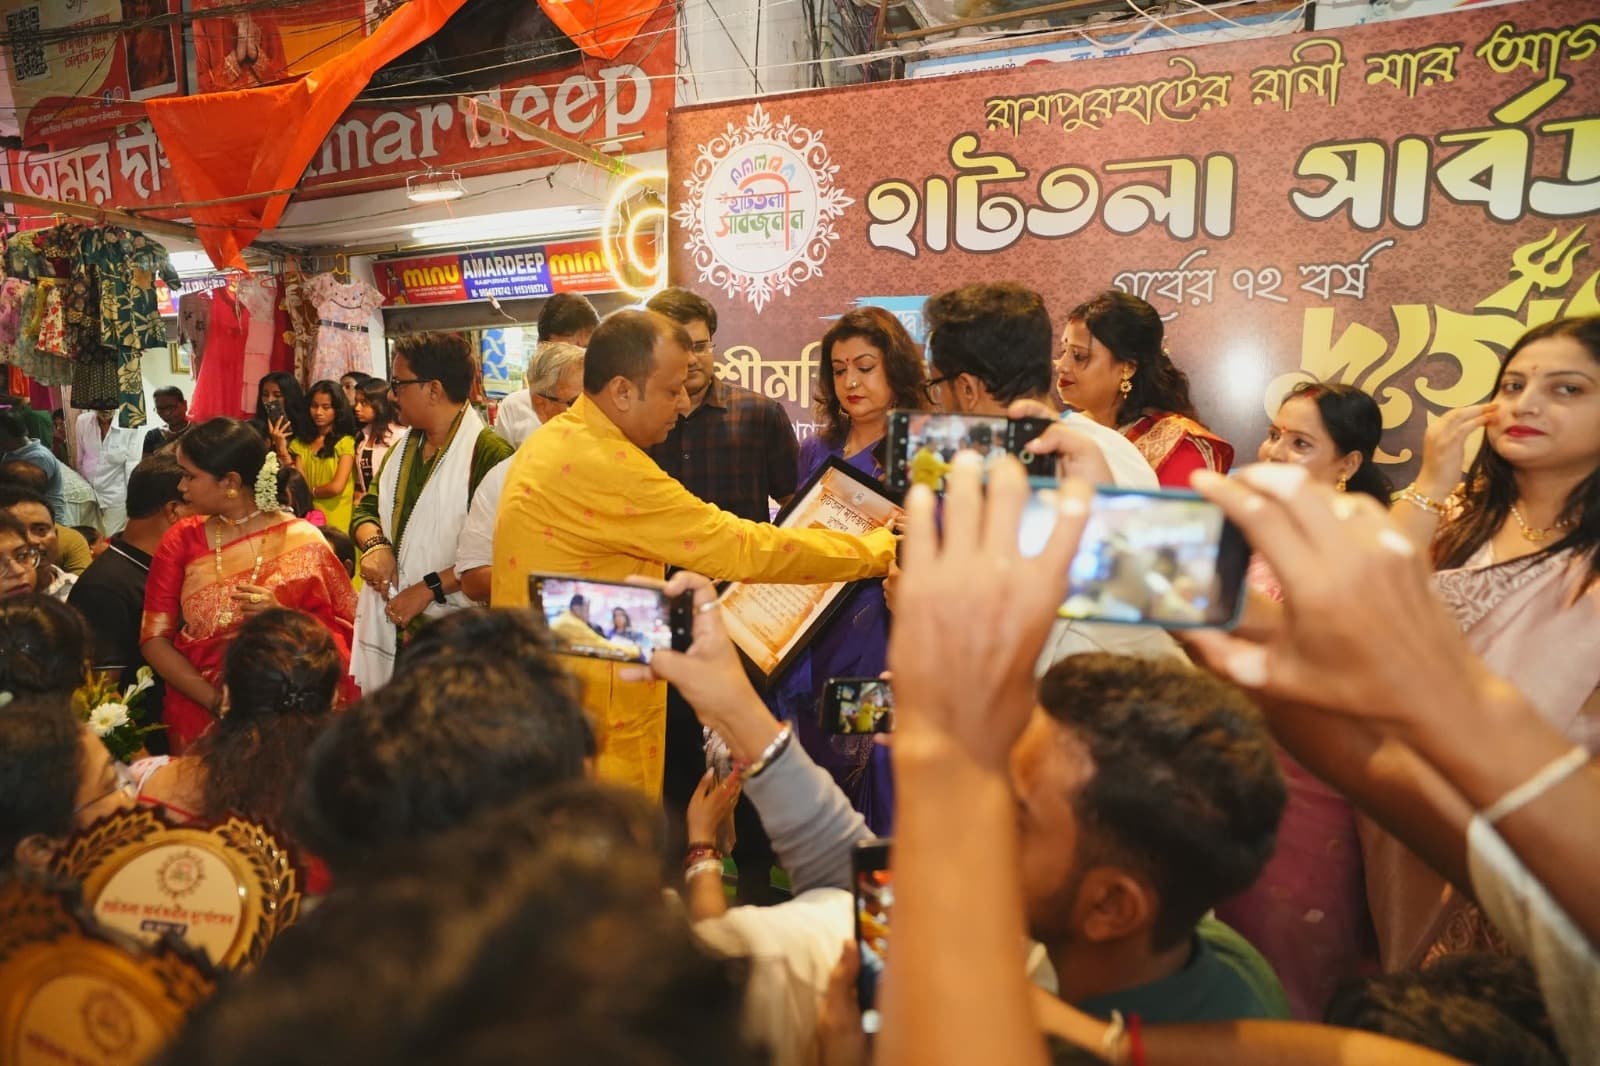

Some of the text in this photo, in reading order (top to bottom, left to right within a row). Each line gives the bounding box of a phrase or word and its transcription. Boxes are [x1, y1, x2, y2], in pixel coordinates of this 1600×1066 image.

[984, 57, 1233, 138] রামপুরহাটের
[1250, 37, 1345, 113] রানী
[1366, 46, 1461, 99] মার
[18, 142, 112, 205] অমর
[116, 118, 171, 200] দী
[304, 101, 454, 178] mar
[865, 136, 1237, 258] হাটতলা
[463, 252, 545, 279] AMARDEEP
[1231, 265, 1289, 303] ৭২
[1299, 239, 1394, 299] বর্ষ
